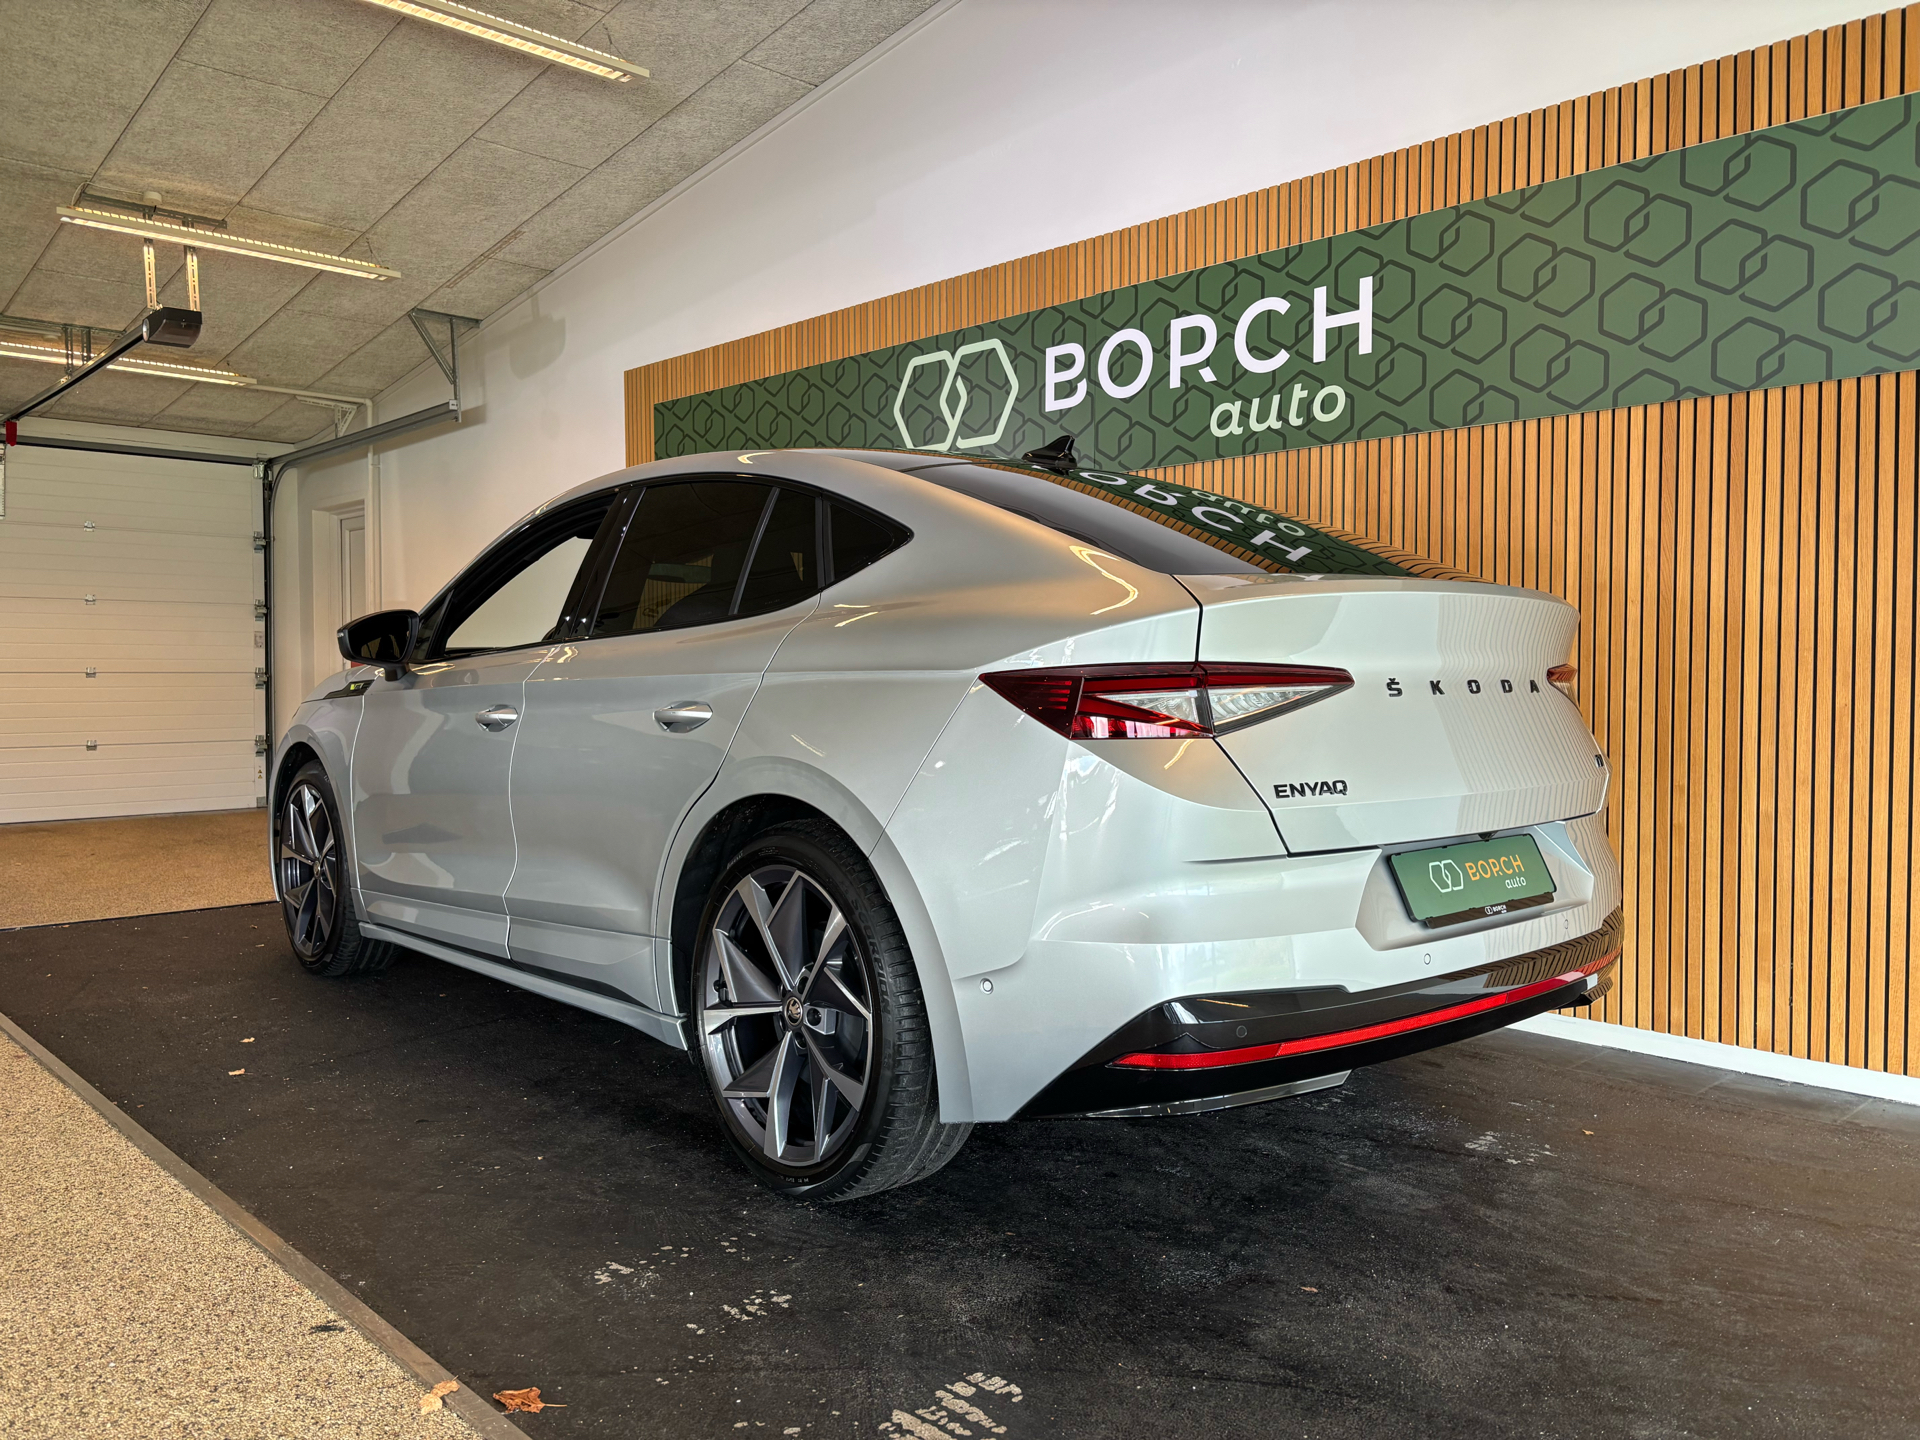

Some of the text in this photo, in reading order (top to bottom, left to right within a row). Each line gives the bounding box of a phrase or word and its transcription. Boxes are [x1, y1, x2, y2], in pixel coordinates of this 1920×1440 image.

[1045, 276, 1374, 413] BORCH
[1209, 383, 1347, 438] auto
[1386, 678, 1540, 698] ŠKODA
[1273, 779, 1348, 800] ENYAQ
[1465, 854, 1525, 881] BORCH
[1505, 876, 1527, 889] auto
[851, 899, 892, 1015] SCORPION
